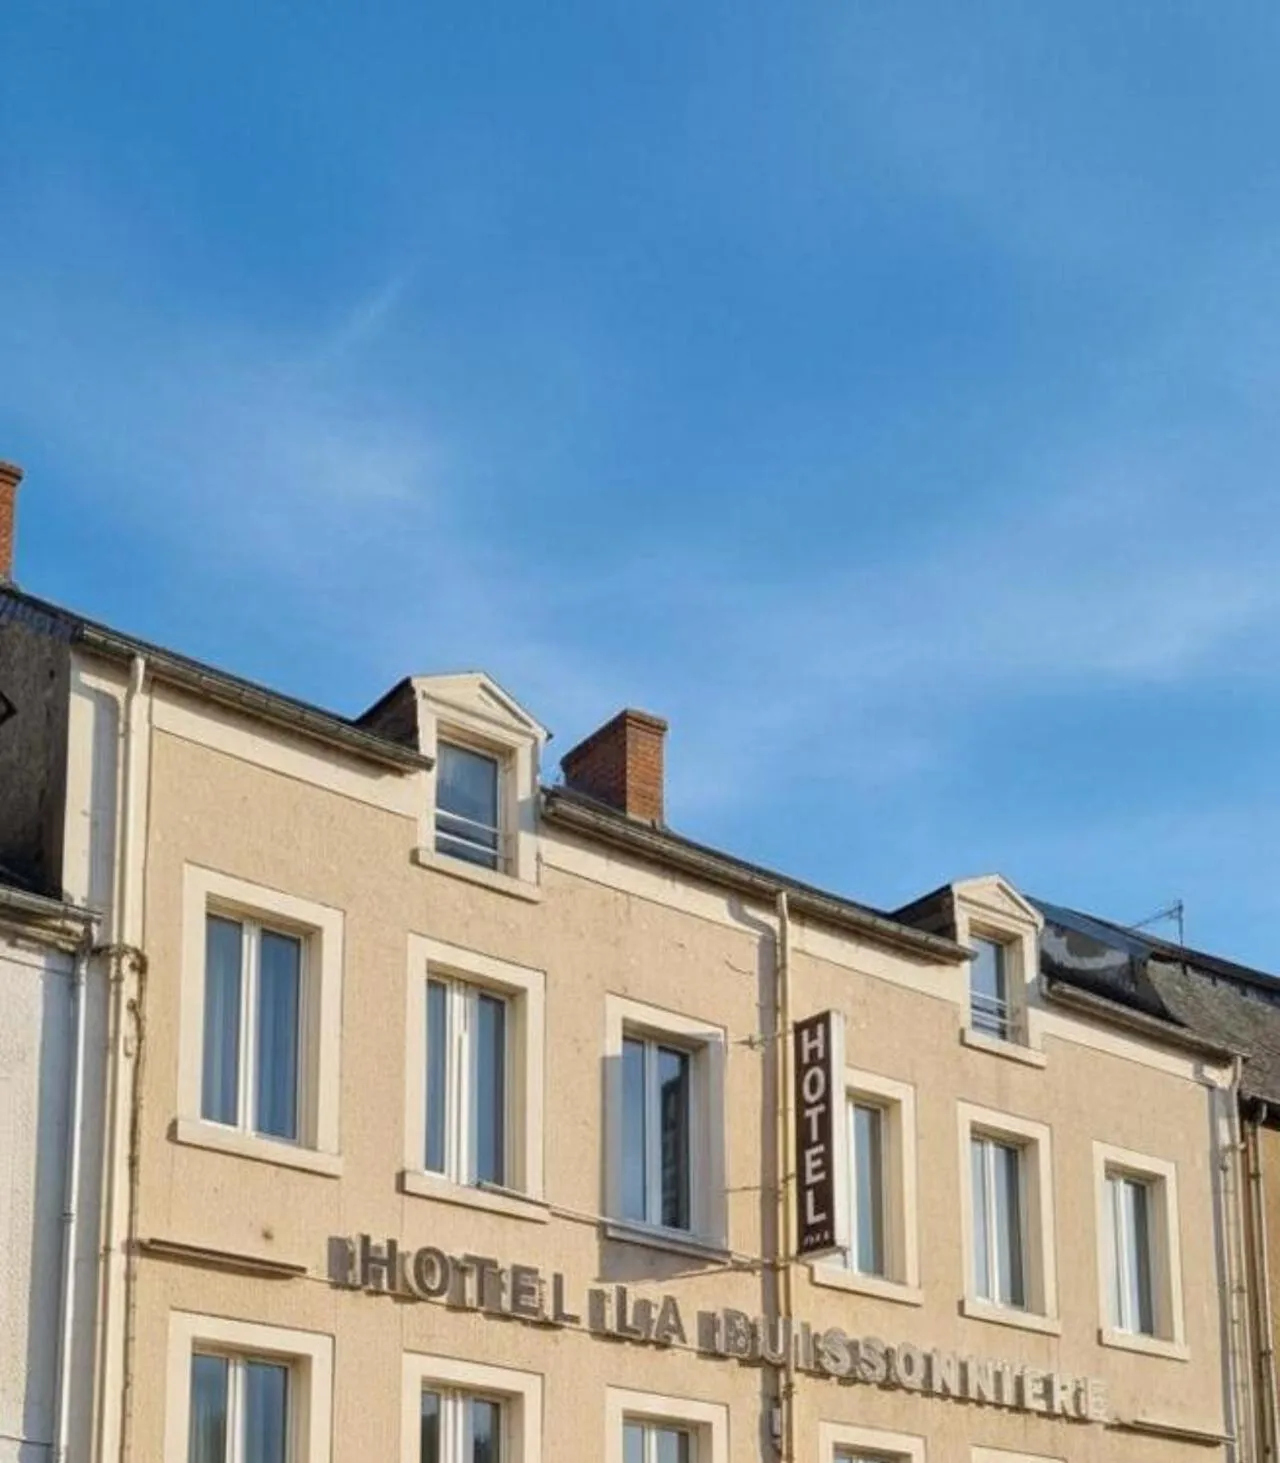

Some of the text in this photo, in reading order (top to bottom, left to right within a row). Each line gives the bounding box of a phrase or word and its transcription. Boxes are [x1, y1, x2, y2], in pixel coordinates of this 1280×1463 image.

[801, 1022, 827, 1226] HOTEL
[348, 1233, 581, 1325] HOTEL
[612, 1284, 688, 1346] LA
